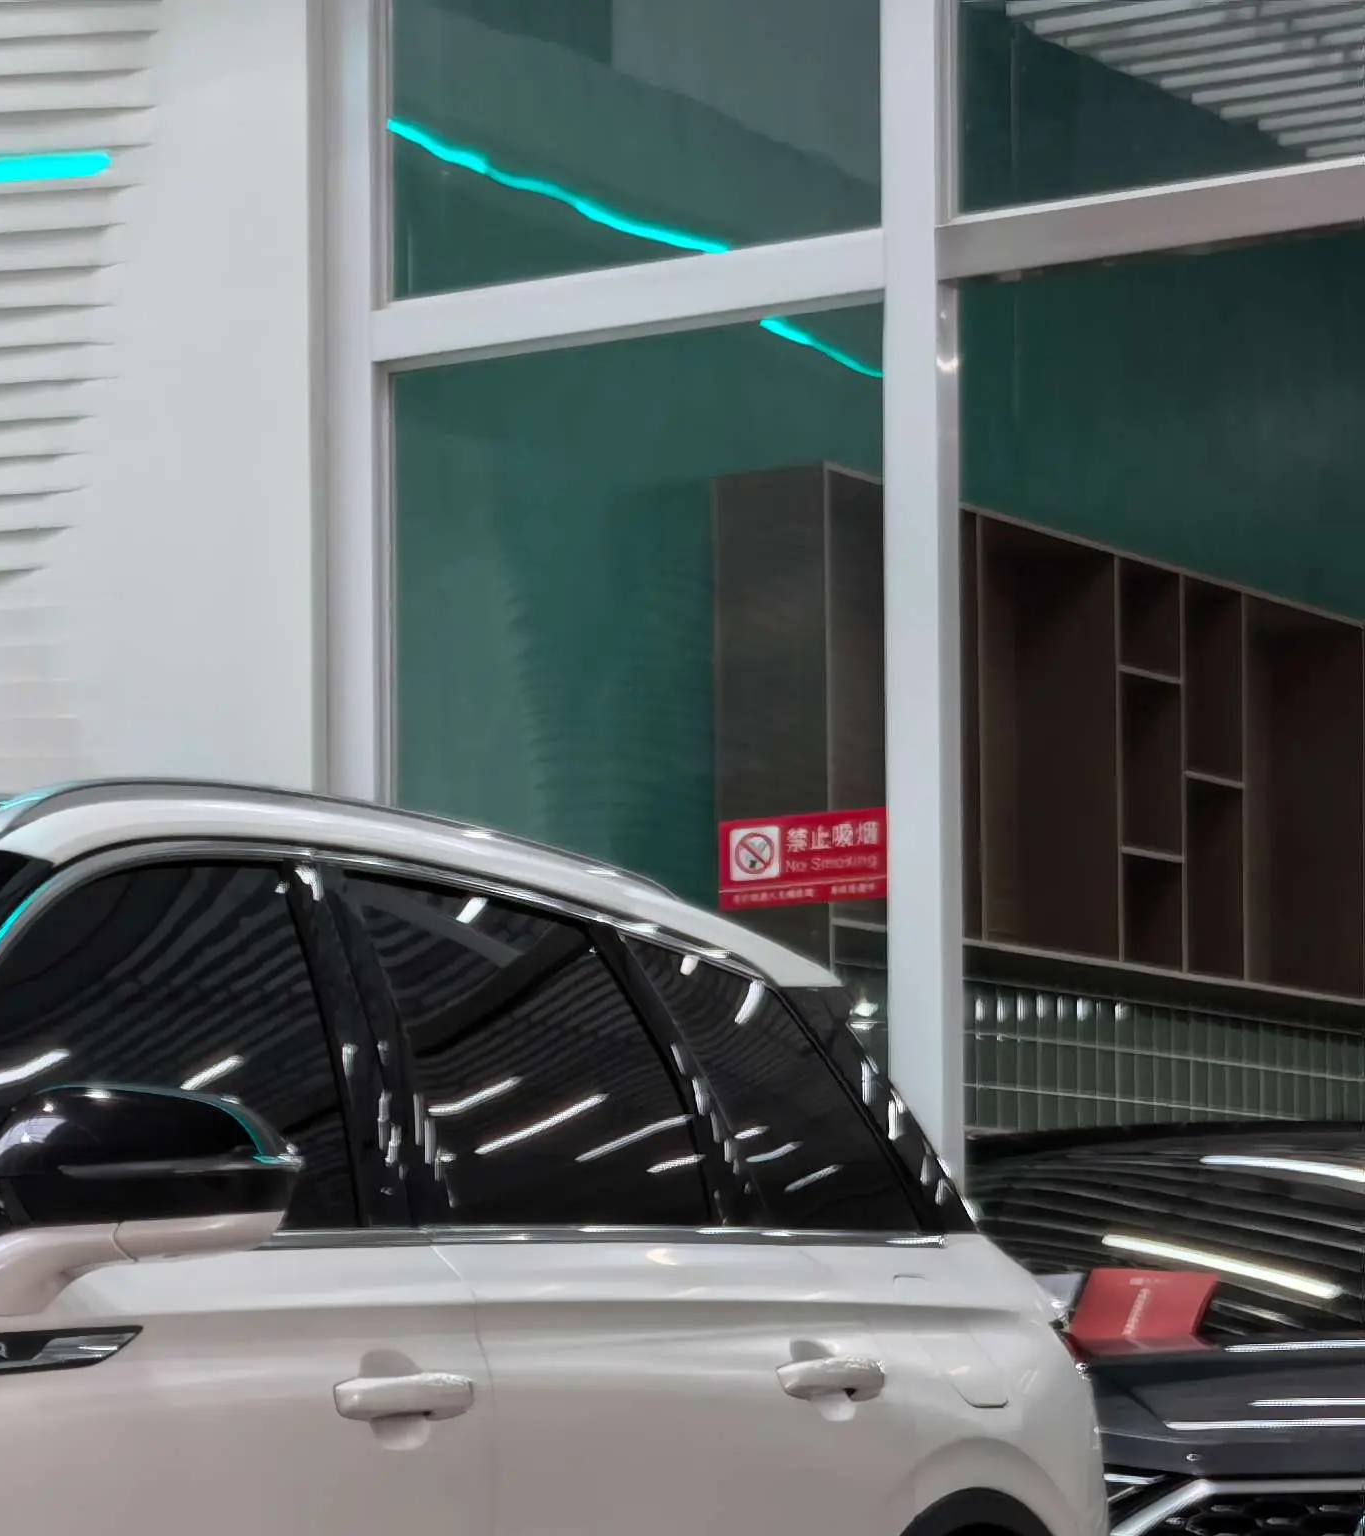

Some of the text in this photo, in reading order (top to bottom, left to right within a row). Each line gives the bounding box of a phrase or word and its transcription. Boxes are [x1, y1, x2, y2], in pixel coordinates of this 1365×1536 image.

[786, 821, 878, 852] 禁止吸烟
[786, 860, 807, 872] No
